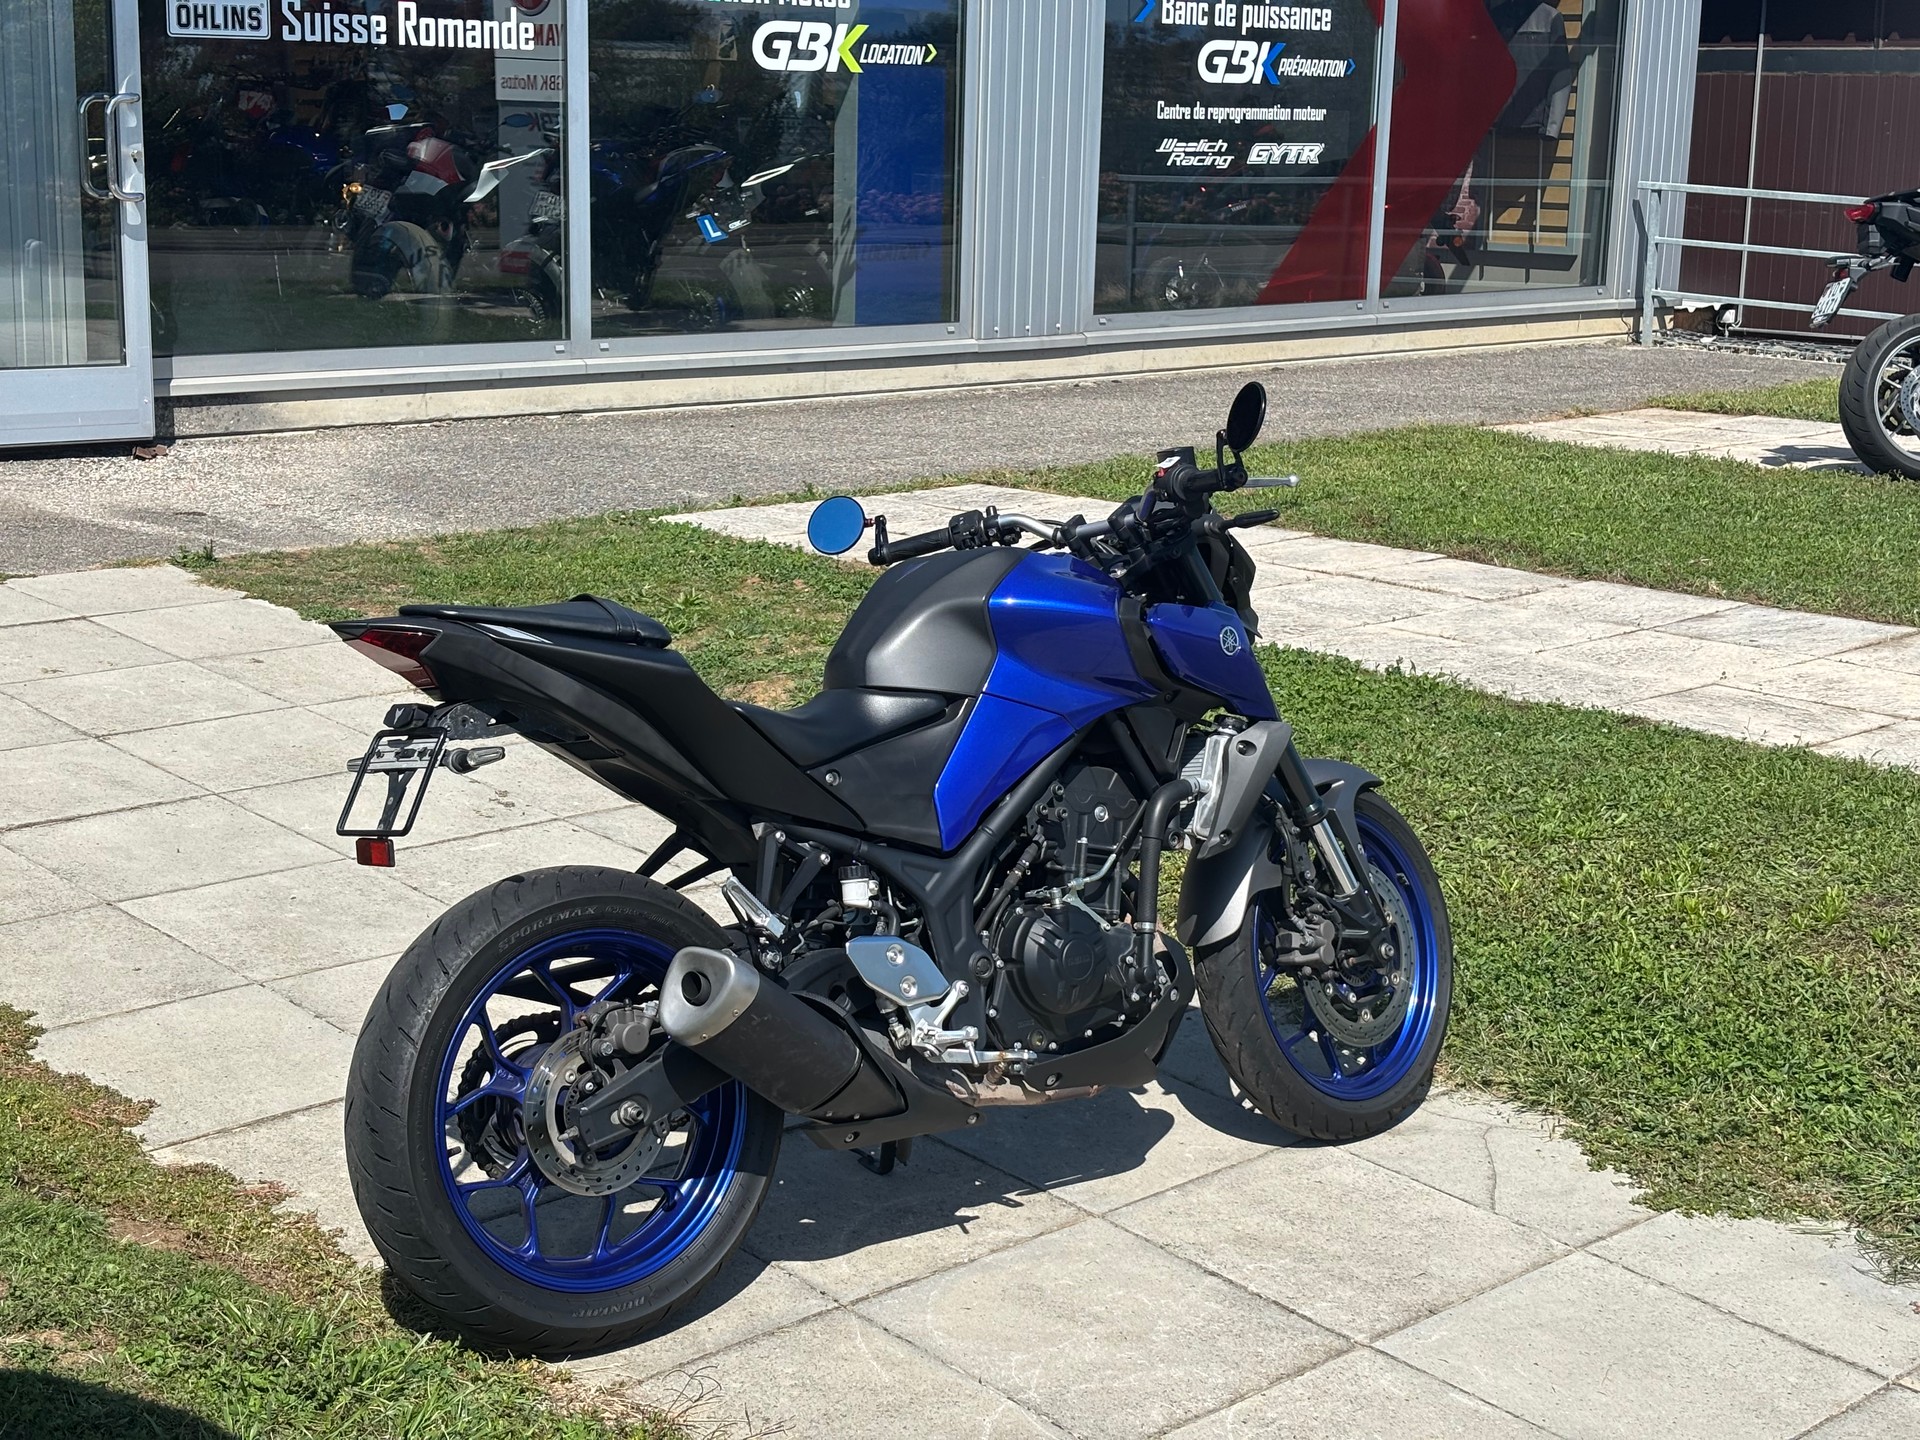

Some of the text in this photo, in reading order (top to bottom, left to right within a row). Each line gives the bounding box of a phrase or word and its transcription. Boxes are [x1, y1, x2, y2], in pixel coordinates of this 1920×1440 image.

[282, 0, 535, 50] Suisse Romande
[1161, 0, 1332, 35] Banc de puissance
[752, 20, 925, 73] GBK LOCATION
[1197, 39, 1347, 85] GBK PRÉPARATION
[1156, 100, 1327, 124] Centre de reprogrammation moteur
[1166, 152, 1235, 169] Racing
[1246, 143, 1324, 165] GYTR
[704, 219, 722, 238] L
